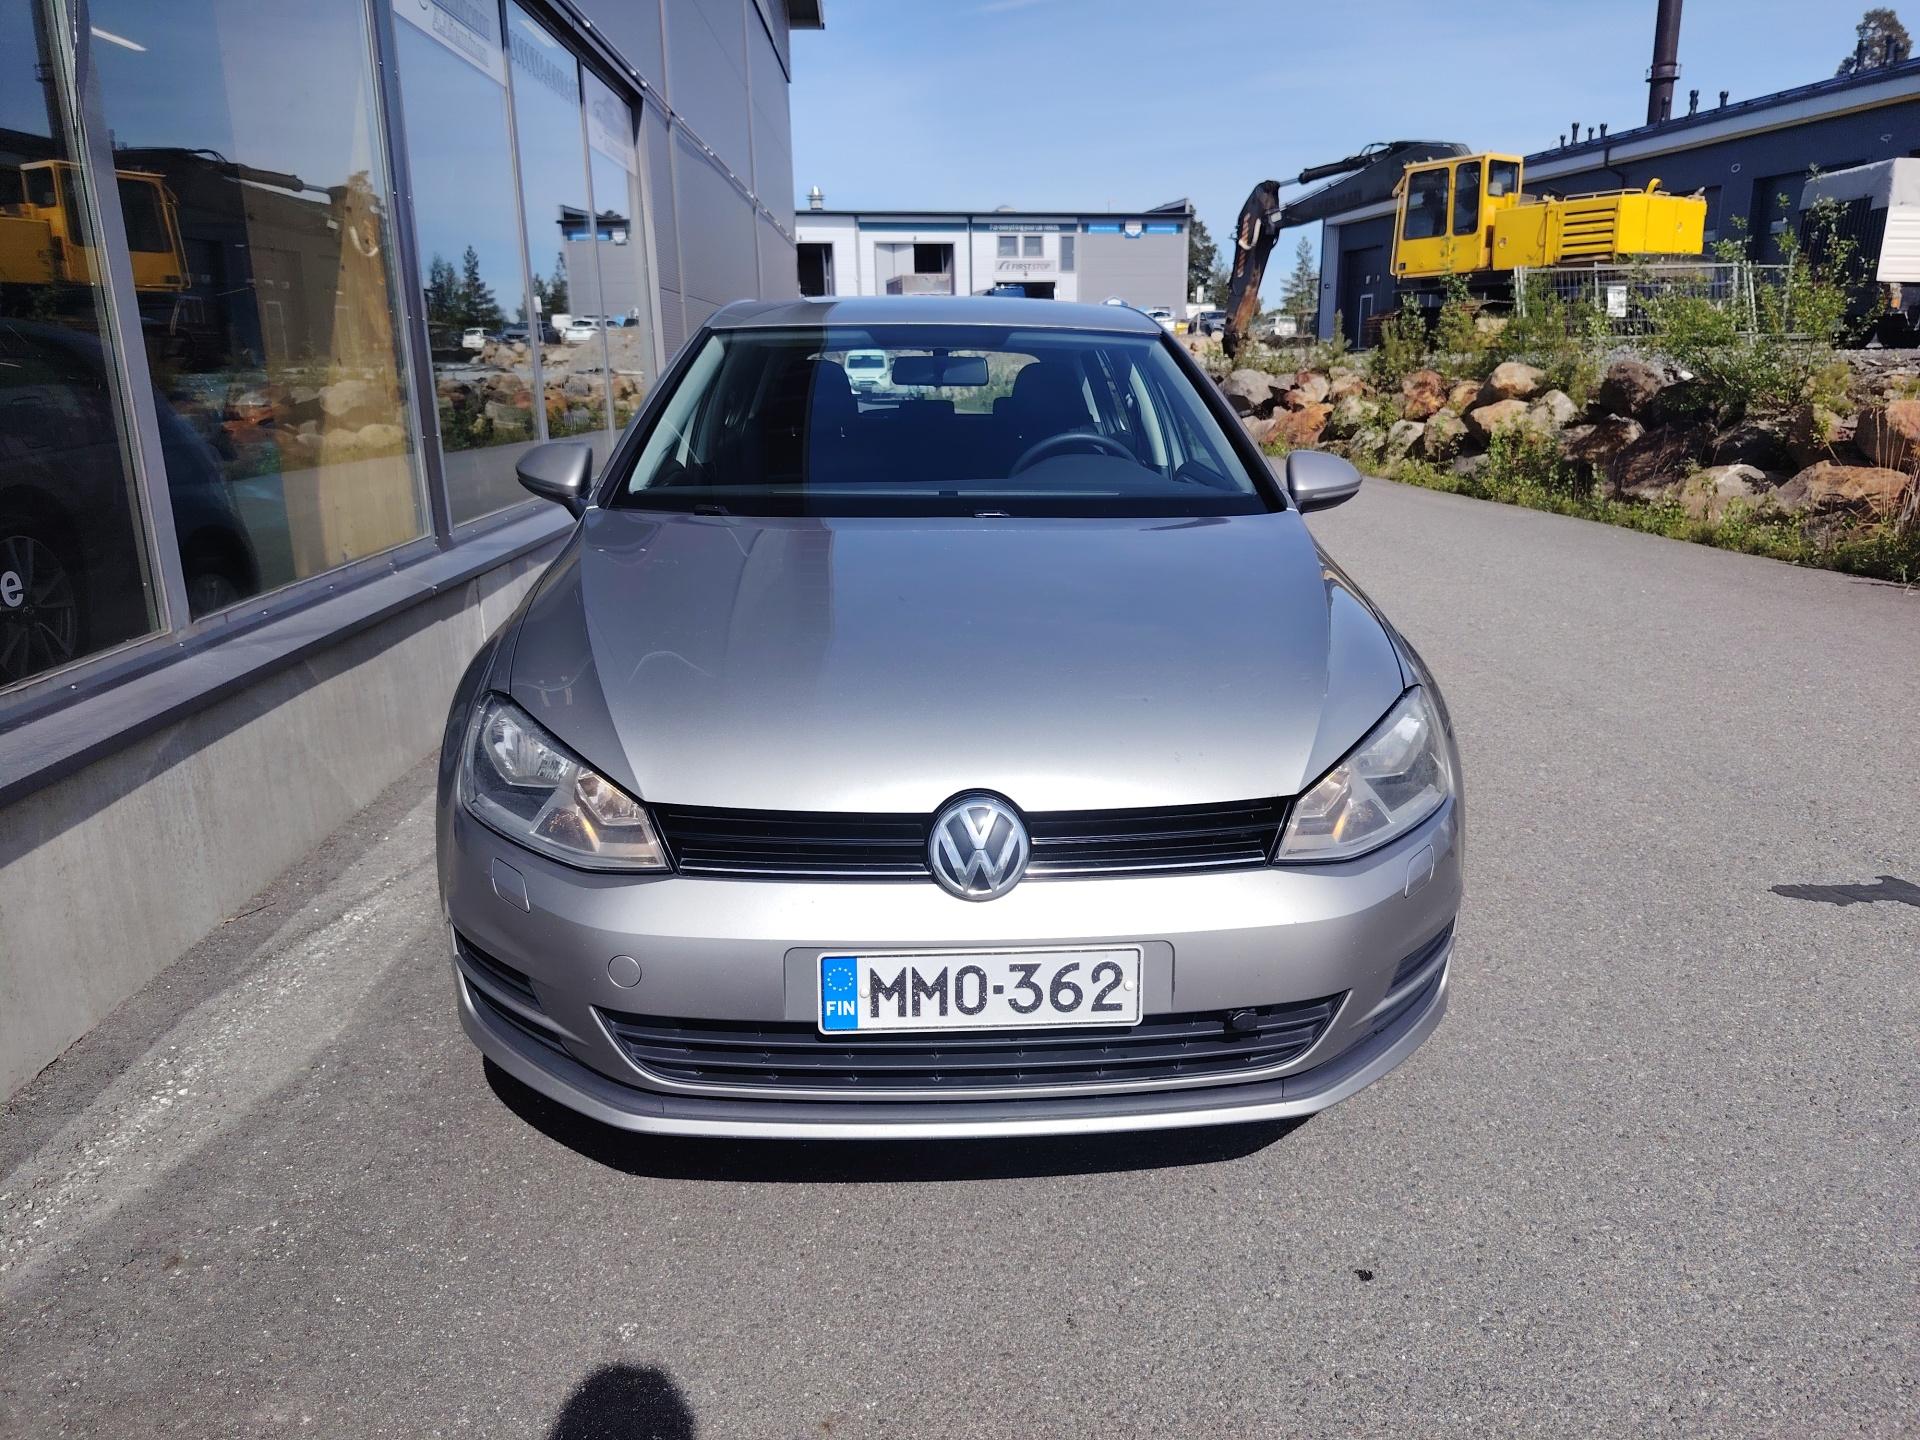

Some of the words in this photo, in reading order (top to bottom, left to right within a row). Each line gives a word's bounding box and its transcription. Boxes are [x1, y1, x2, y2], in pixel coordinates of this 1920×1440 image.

[938, 805, 1020, 894] VW
[826, 1000, 855, 1017] FIN
[869, 961, 1124, 1018] MMO-362
